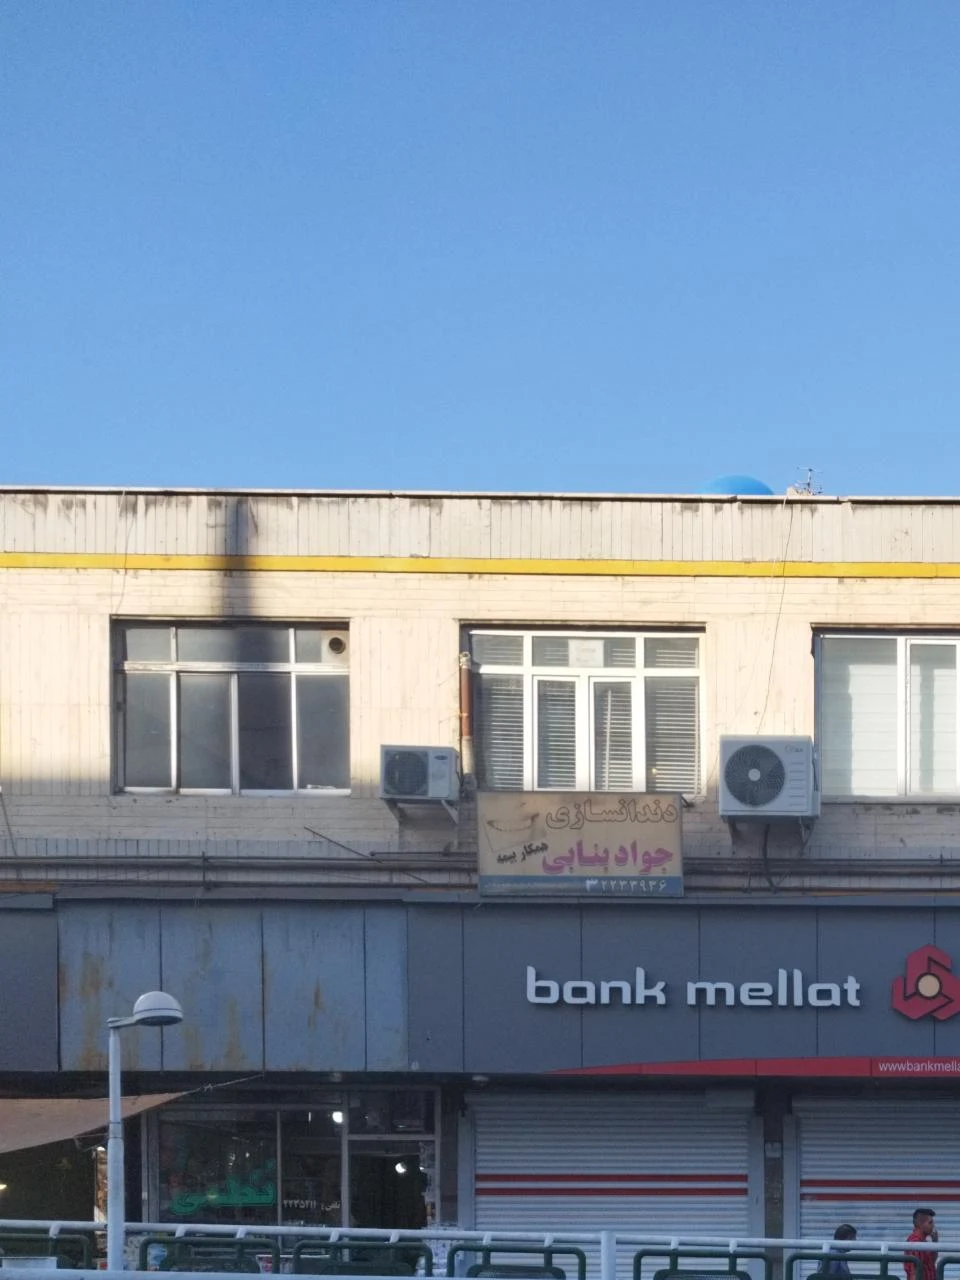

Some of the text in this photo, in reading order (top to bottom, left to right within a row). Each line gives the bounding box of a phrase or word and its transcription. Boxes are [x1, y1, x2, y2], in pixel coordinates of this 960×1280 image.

[614, 840, 673, 876] جواد
[526, 966, 861, 1007] bank mellat
